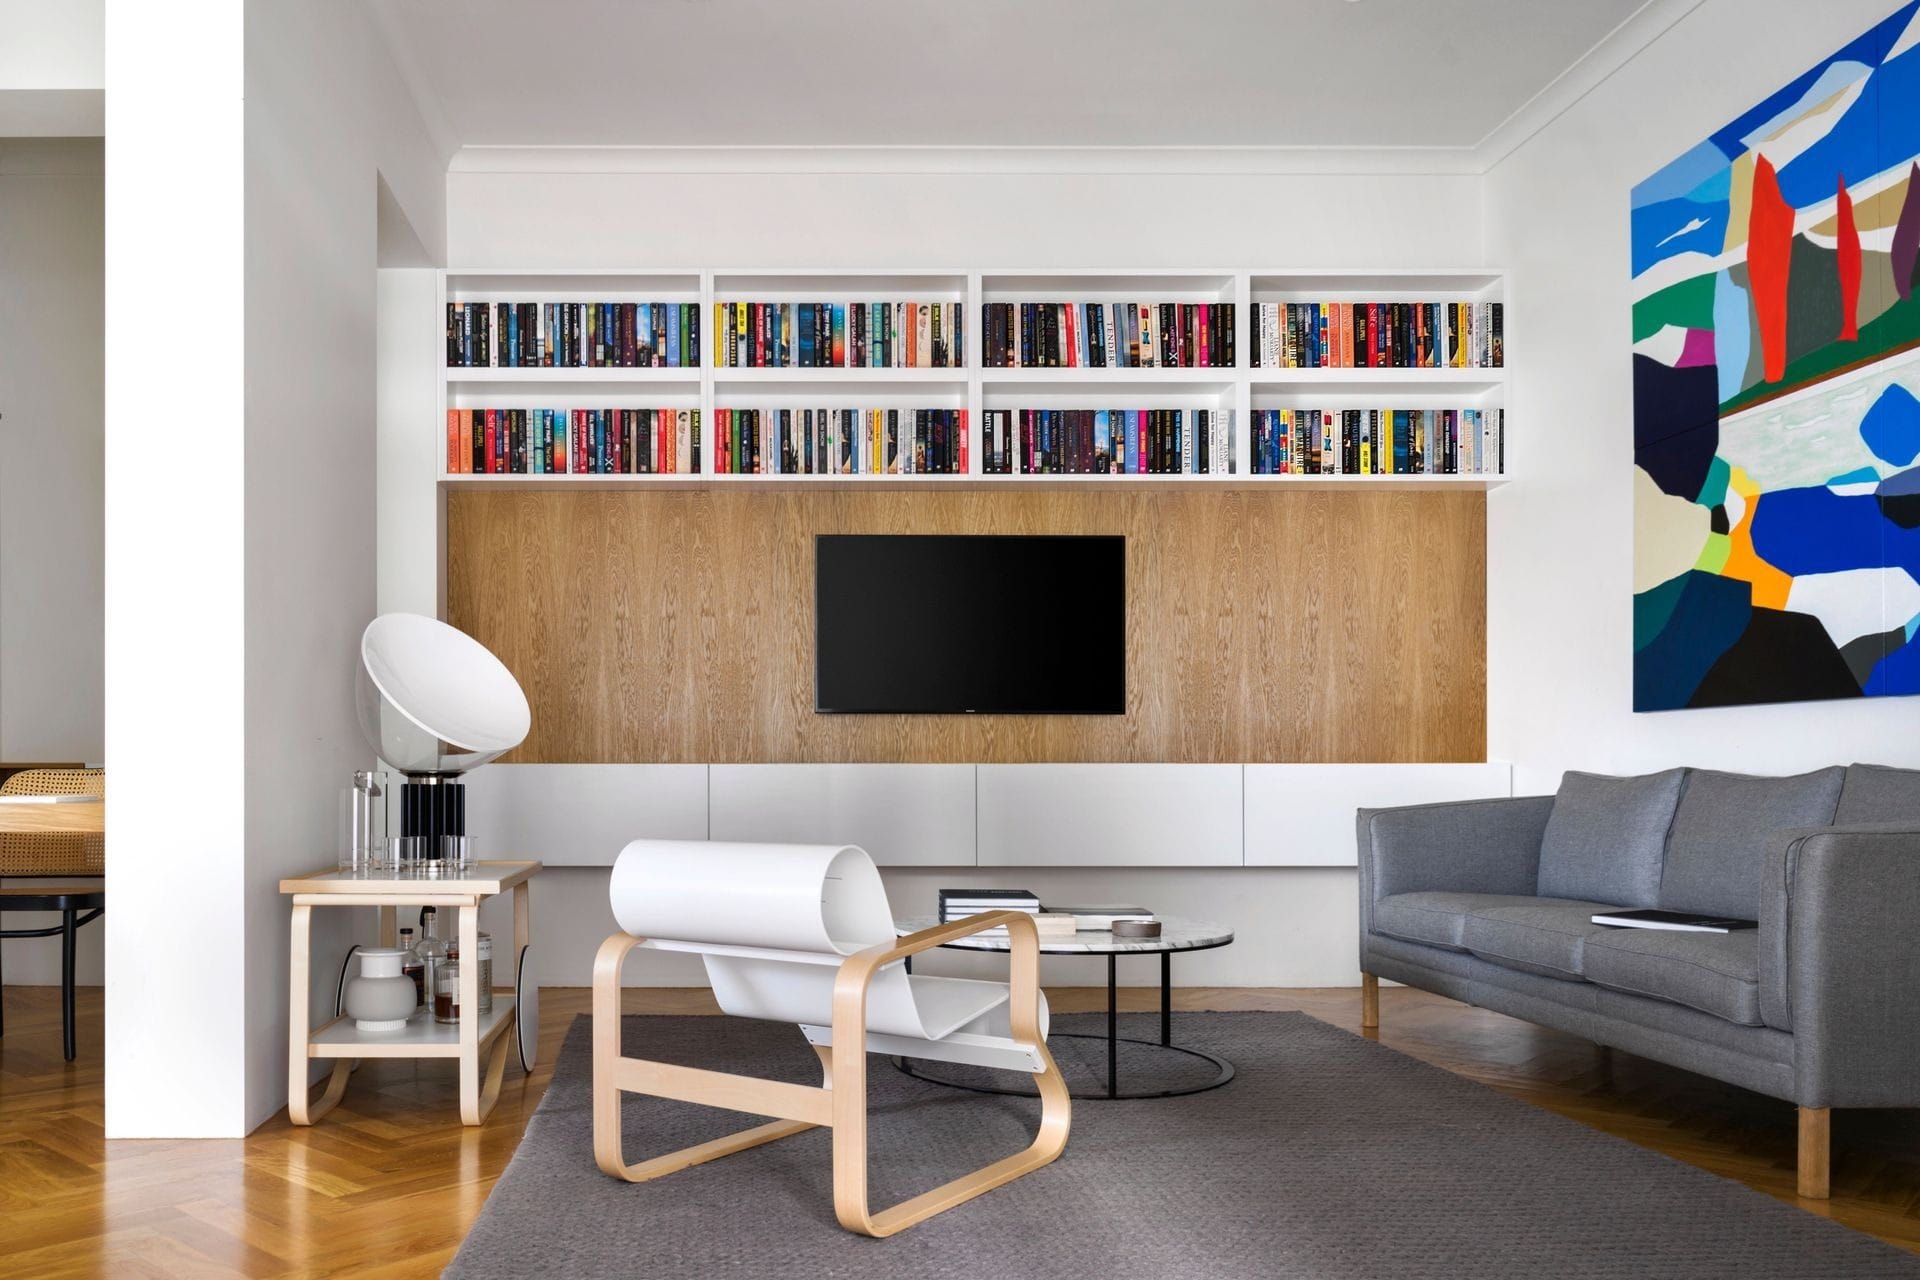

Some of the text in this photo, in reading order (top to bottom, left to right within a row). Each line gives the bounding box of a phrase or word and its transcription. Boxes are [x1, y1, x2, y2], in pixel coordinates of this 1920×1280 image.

[1107, 322, 1115, 362] TENDER
[1169, 352, 1178, 360] X
[605, 458, 614, 466] X
